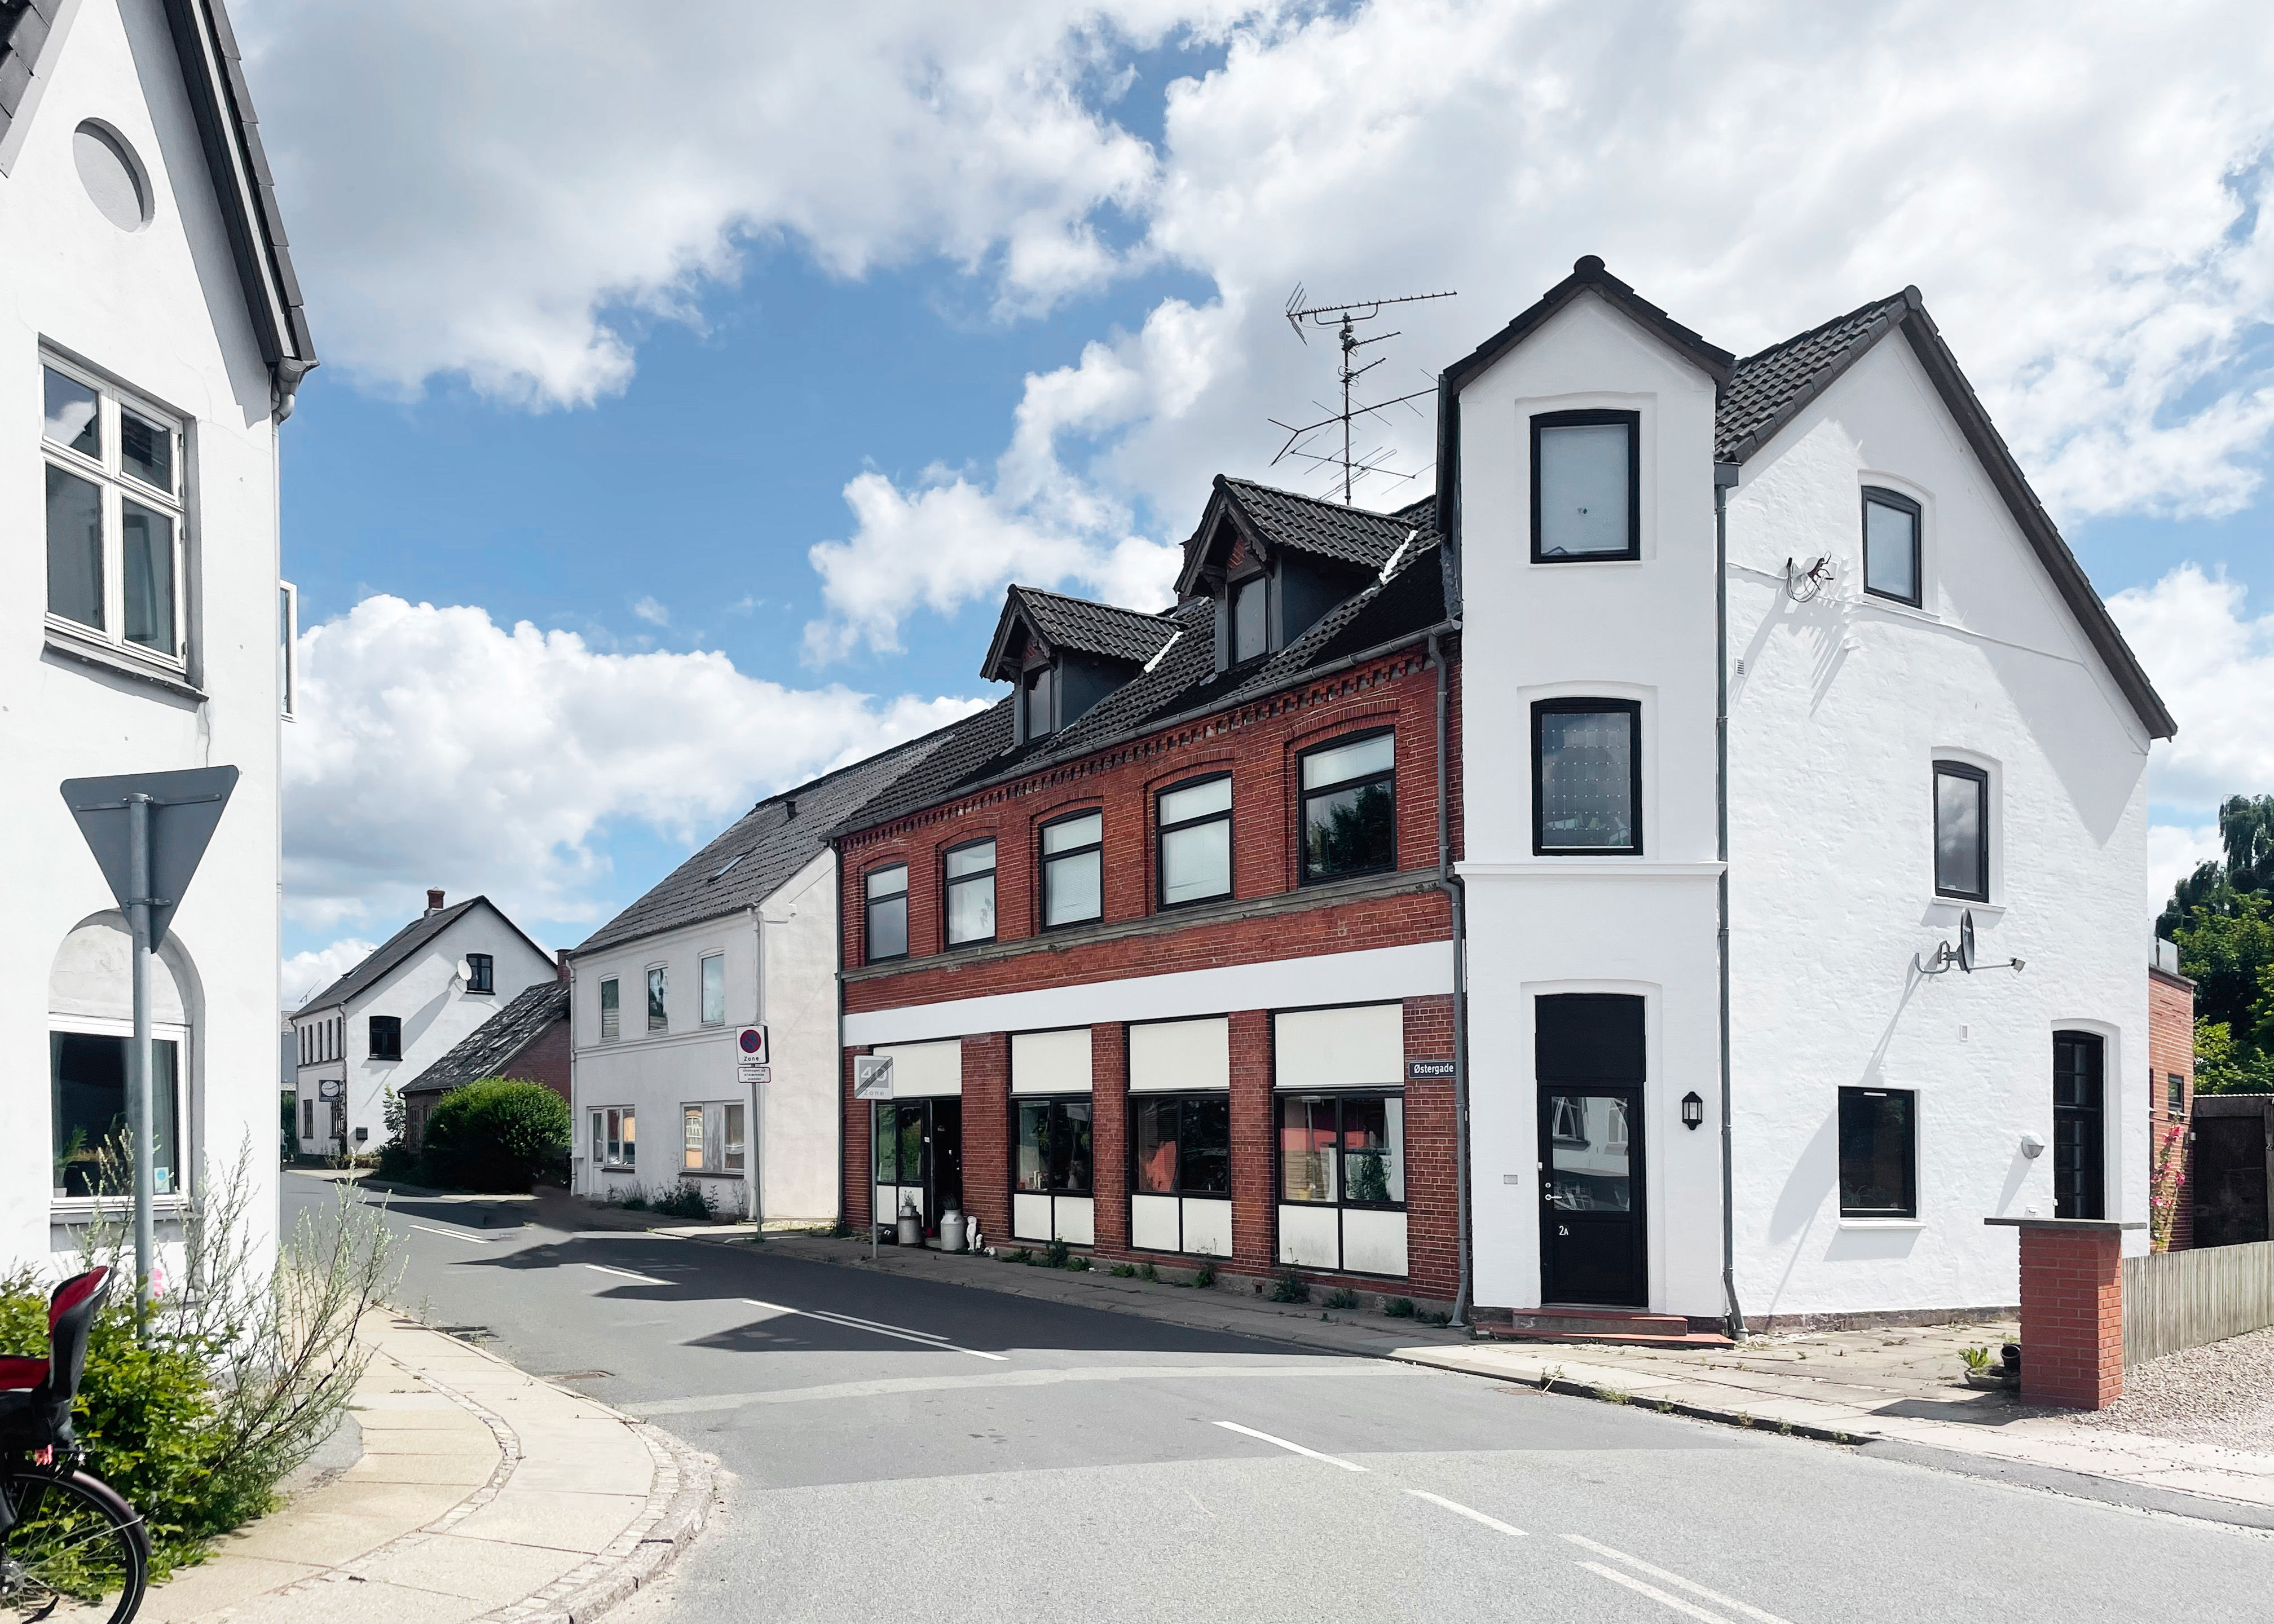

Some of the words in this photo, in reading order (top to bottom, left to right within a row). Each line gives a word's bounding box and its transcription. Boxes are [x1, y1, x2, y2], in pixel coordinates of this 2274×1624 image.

[861, 1066, 887, 1082] 40
[1414, 1063, 1453, 1074] Østergade
[1559, 1225, 1568, 1235] 2A
